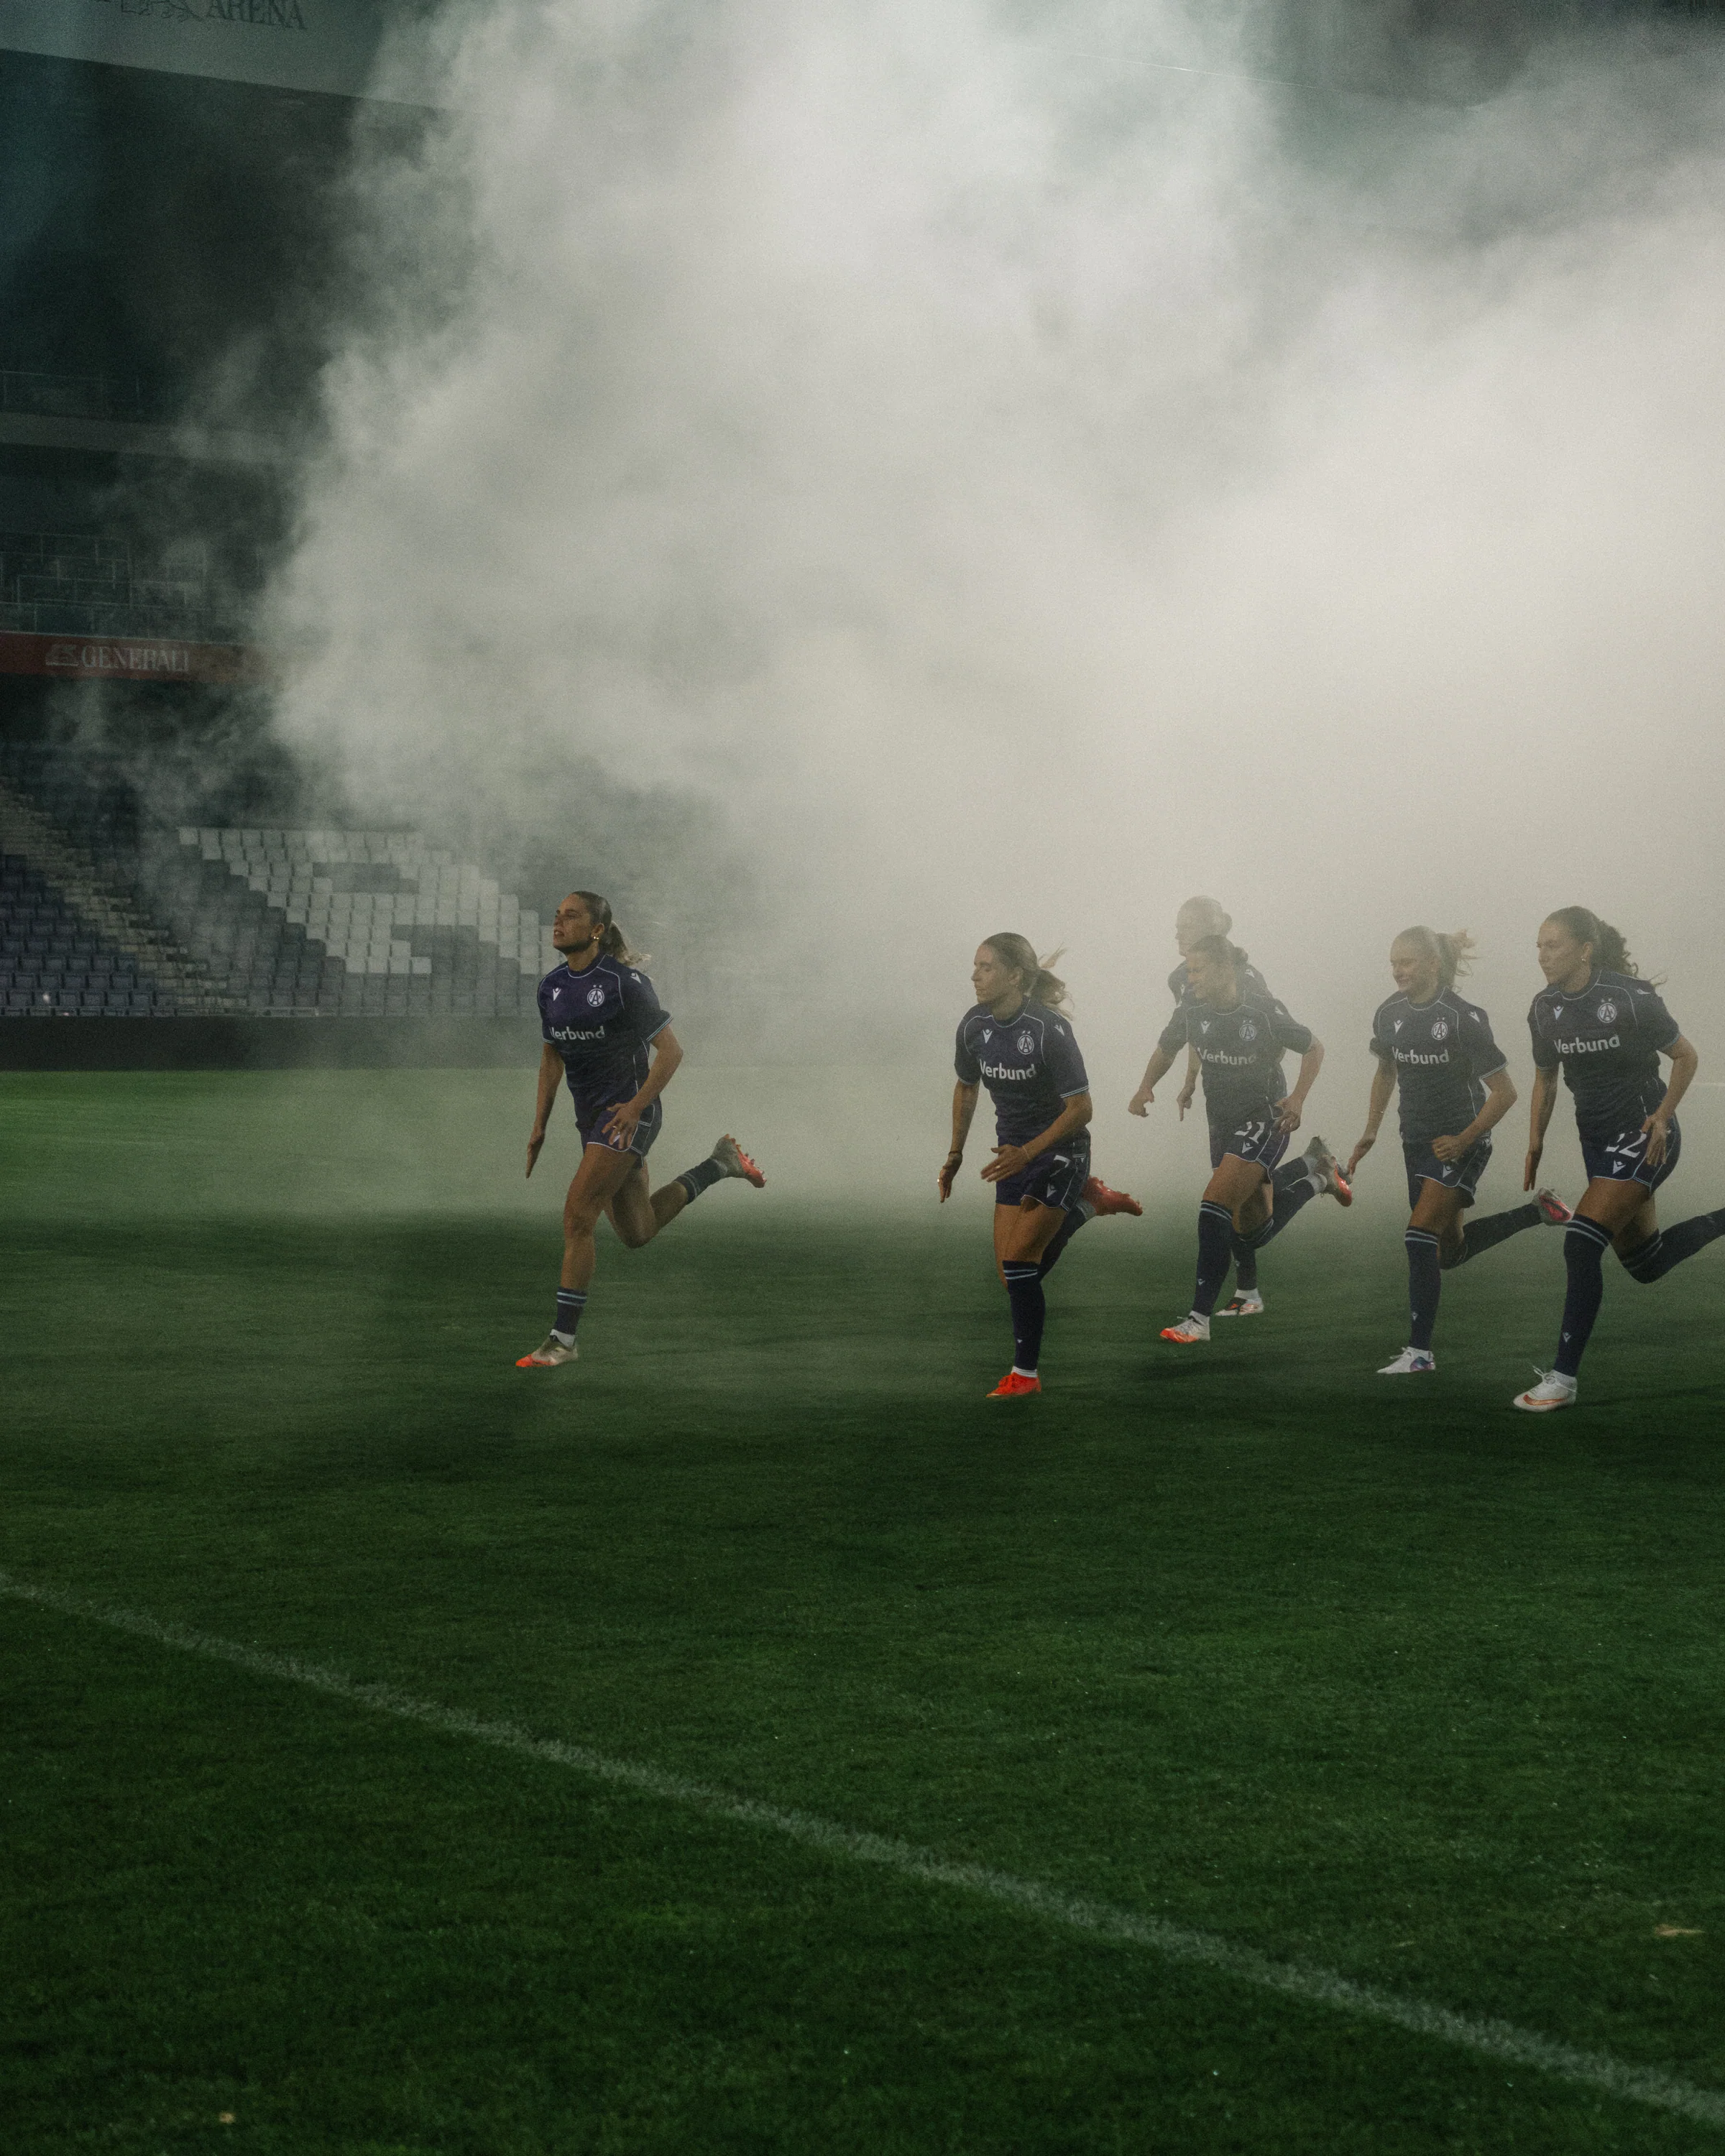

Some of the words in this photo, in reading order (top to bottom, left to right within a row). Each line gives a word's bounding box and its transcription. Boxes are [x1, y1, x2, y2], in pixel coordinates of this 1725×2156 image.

[81, 645, 189, 672] GENERALI
[1553, 1034, 1621, 1054] Verbund
[1392, 1046, 1450, 1064] Verbund
[980, 1059, 1036, 1080] Verbund
